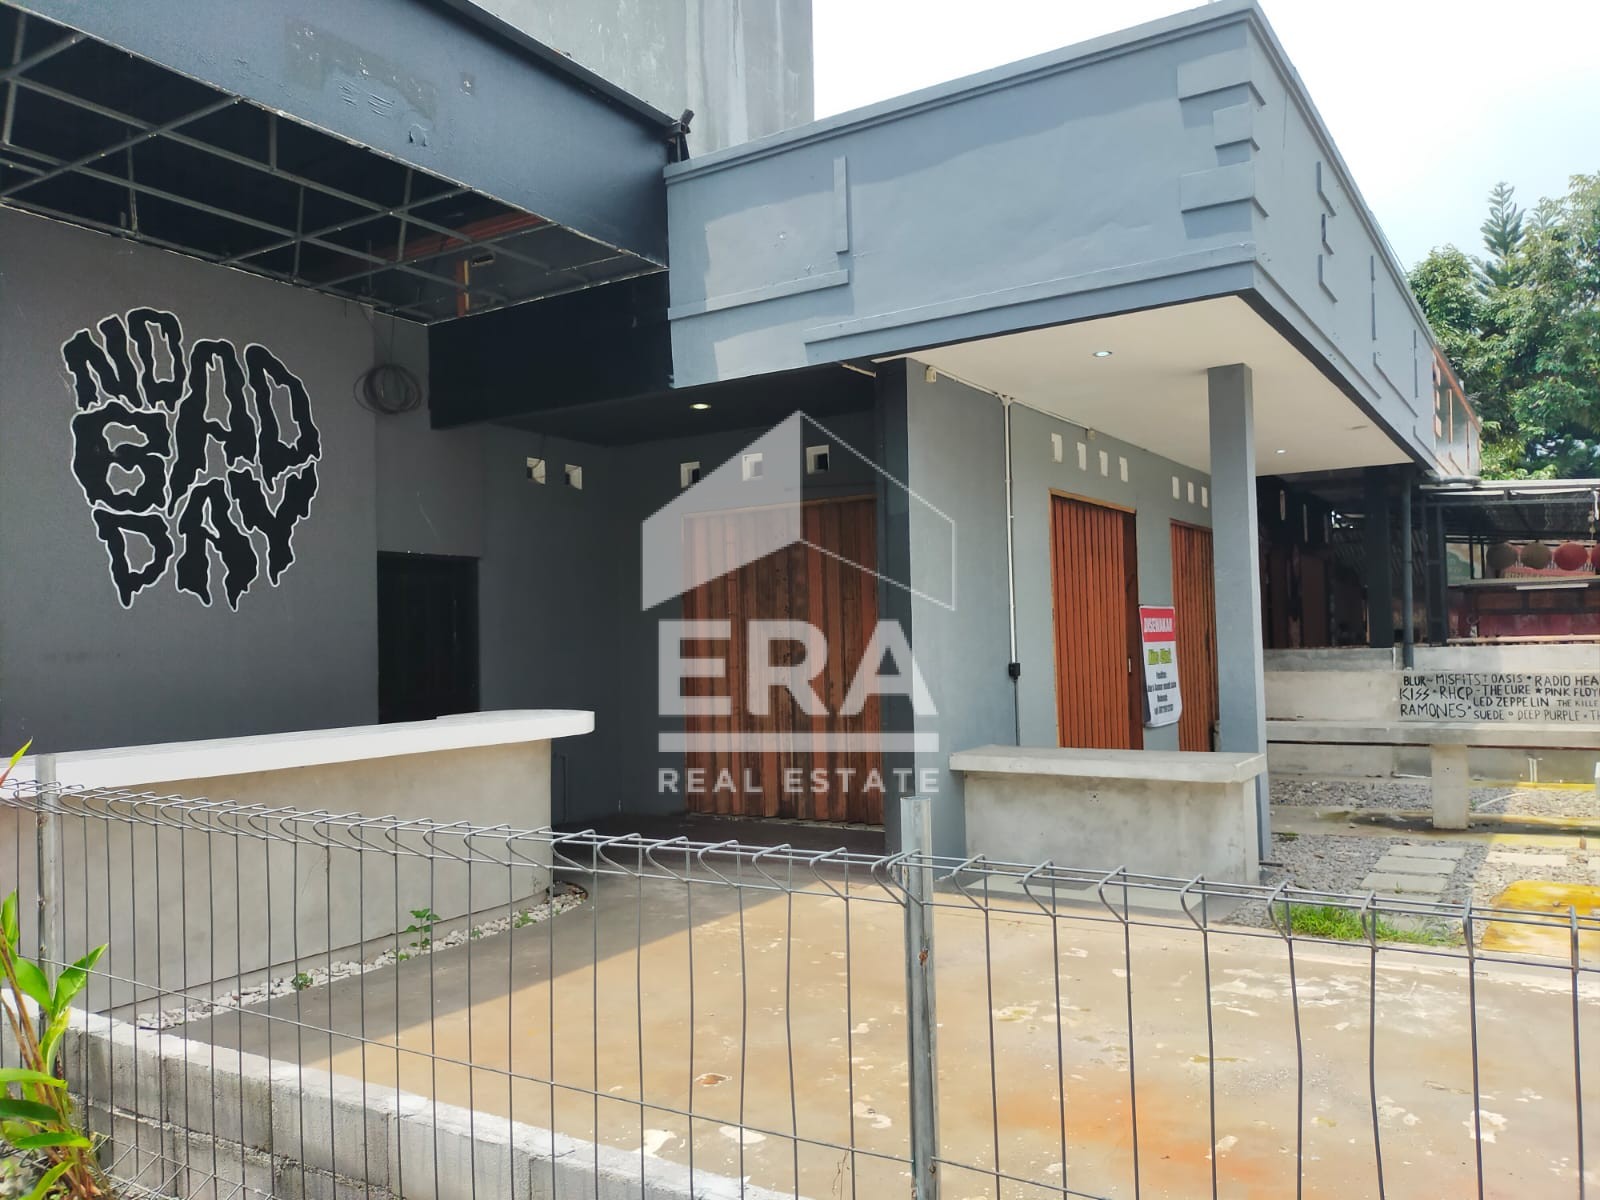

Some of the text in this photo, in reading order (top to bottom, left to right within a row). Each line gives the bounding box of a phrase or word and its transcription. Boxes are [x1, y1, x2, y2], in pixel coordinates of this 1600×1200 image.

[61, 307, 184, 413] NO
[71, 338, 321, 518] BAD
[92, 460, 319, 612] DAY
[1403, 675, 1426, 687] BLUR
[1435, 674, 1481, 686] MISFITS
[1491, 673, 1523, 684] OASIS
[1535, 675, 1571, 687] RADIO
[1400, 684, 1600, 701] KISS RHCP THE CURE PINK FLOY
[1474, 696, 1493, 707] LED
[1496, 696, 1549, 708] ZEPPELIN
[1400, 703, 1467, 719] RAMONES
[1473, 710, 1504, 721] SUEDE
[1517, 710, 1540, 720] DEEP
[1543, 710, 1581, 722] PURPLE
